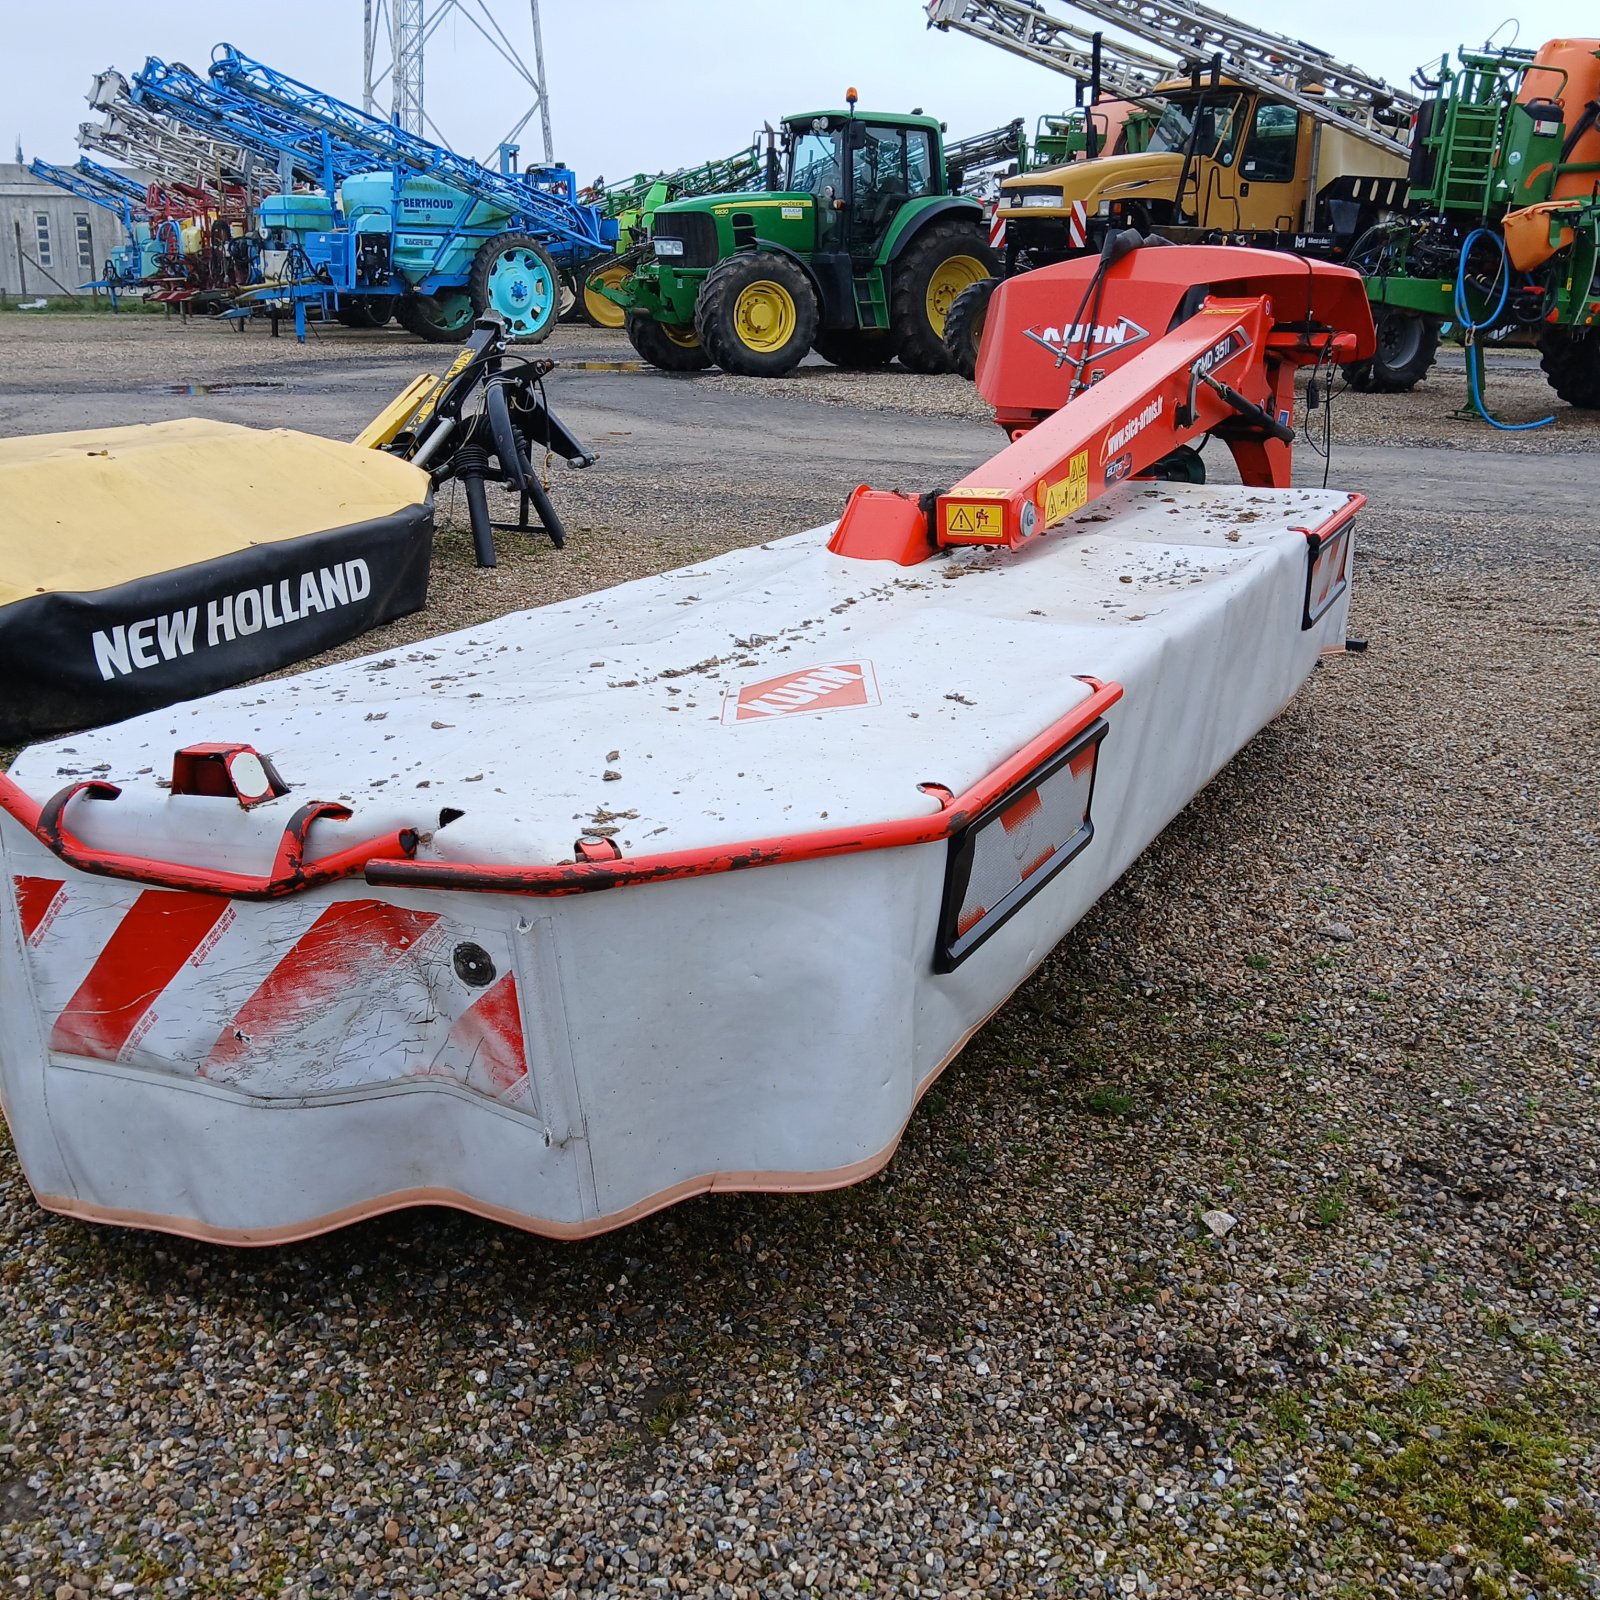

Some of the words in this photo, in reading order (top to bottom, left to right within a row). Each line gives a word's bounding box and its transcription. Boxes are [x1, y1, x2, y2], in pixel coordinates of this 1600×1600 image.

[404, 198, 454, 209] BERTHOUD
[1214, 335, 1230, 363] 3511
[92, 606, 198, 682] NEW
[206, 558, 371, 647] HOLLAND
[735, 666, 866, 716] KUHN
